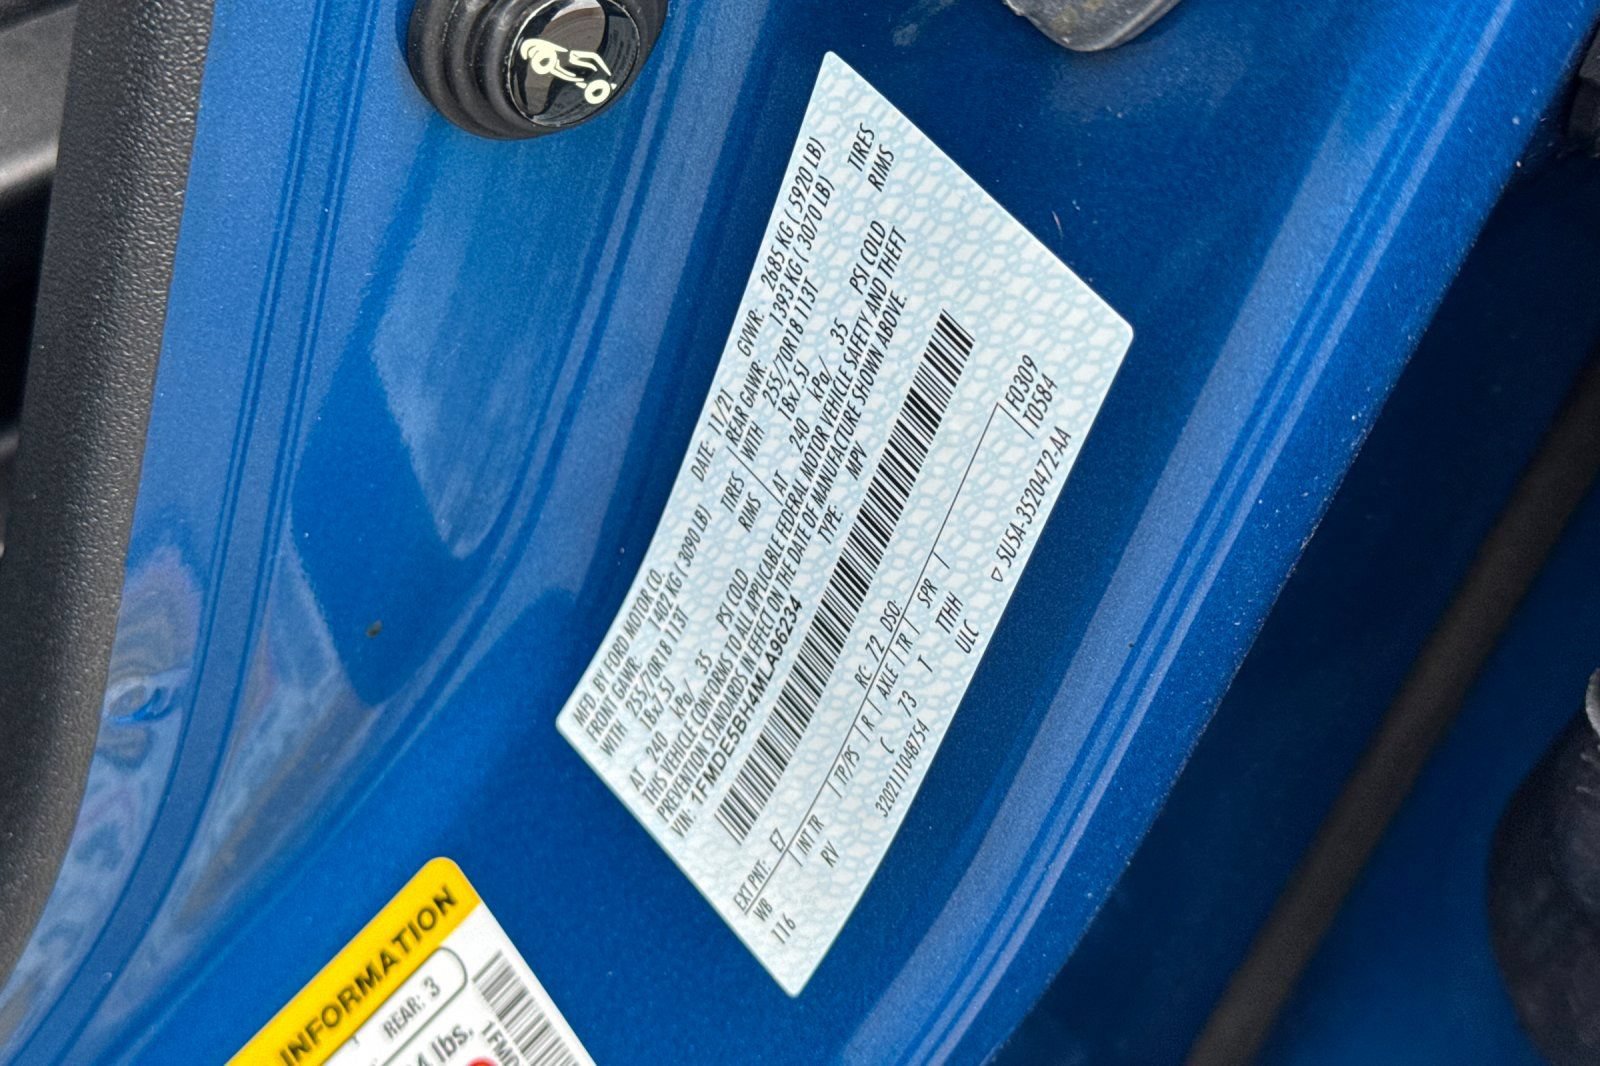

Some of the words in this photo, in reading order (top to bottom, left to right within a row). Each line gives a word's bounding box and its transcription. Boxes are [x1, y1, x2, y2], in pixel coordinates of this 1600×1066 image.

[737, 309, 764, 357] GVWR:
[761, 245, 785, 292] 2685
[775, 221, 794, 250] KG
[788, 166, 813, 213] 5920
[803, 137, 826, 169] LB)
[740, 421, 764, 461] WITH
[762, 318, 804, 407] 255/70R18
[794, 277, 818, 320] 113T
[847, 123, 875, 172] TIRES
[778, 359, 810, 421] 18x7.5J
[868, 144, 894, 192] RIMS
[725, 405, 749, 447] REAR
[740, 360, 767, 408] GAWR:
[769, 283, 794, 326] 1393
[784, 258, 803, 287] KG
[797, 204, 822, 251] 3070
[812, 175, 835, 207] LB)
[772, 470, 788, 497] AT
[789, 417, 810, 453] 240
[807, 356, 833, 403] kPa/
[830, 317, 848, 346] 35
[849, 263, 870, 295] PSI
[860, 220, 885, 266] COLD
[875, 291, 907, 349] ABOVE.
[852, 343, 884, 406] SHOWN
[1005, 355, 1038, 412] F0309
[1022, 373, 1057, 429] T0584
[691, 441, 715, 482] DATE:
[708, 388, 734, 436] 11/21
[810, 400, 862, 509] MANUFACTURE
[641, 771, 667, 805] THIS
[660, 720, 698, 776] VEHICLE
[691, 652, 733, 726] CONFORMS
[724, 634, 742, 658] TO
[734, 611, 754, 640] ALL
[745, 534, 785, 616] APPLICABLE
[775, 478, 809, 540] FEDERAL
[799, 425, 830, 482] MOTOR
[819, 365, 853, 428] VEHICLE
[843, 310, 873, 370] SAFETY
[865, 277, 887, 317] AND
[877, 226, 906, 279] THEFT
[802, 502, 818, 529] OF
[817, 505, 843, 544] TYPE:
[845, 441, 867, 481] MPV
[996, 426, 1071, 568] 5U5A-3520472-AA
[775, 558, 797, 591] THE
[787, 523, 811, 565] DATE
[573, 693, 596, 727] MFD.
[592, 669, 609, 693] BY
[603, 635, 629, 674] FORD
[623, 588, 654, 639] MOTOR
[646, 568, 665, 592] CO.
[586, 695, 617, 742] FRONT
[612, 657, 641, 700] GAWR:
[648, 592, 673, 631] 1402
[665, 572, 682, 597] KG
[678, 527, 701, 567] 3090
[692, 504, 712, 533] LB)
[600, 720, 627, 757] WITH
[625, 639, 672, 717] 255/70R18
[665, 605, 689, 643] 113T
[720, 471, 744, 513] TIRES
[639, 675, 675, 731] 18x7.5J
[738, 492, 761, 533] RIMS
[747, 607, 775, 658] EFFECT
[767, 586, 785, 613] ON
[854, 665, 872, 690] RC:
[865, 635, 885, 662] 72
[880, 600, 902, 633] DSO:
[955, 619, 979, 654] ULC
[629, 766, 646, 791] AT
[645, 731, 668, 764] 240
[669, 678, 695, 720] kPa/
[694, 649, 712, 675] 35
[715, 602, 735, 631] PSI
[726, 568, 749, 607] COLD
[702, 668, 748, 747] STANDARDS
[740, 652, 756, 674] IN
[671, 810, 696, 838] VIN:
[692, 594, 802, 804] 1FMDE5BH4MLA96234
[753, 898, 772, 922] WB
[796, 828, 815, 856] INT
[807, 814, 824, 834] TR
[834, 745, 860, 785] TP/PS
[861, 715, 875, 731] R
[876, 663, 898, 700] AXLE
[895, 632, 913, 654] TR
[917, 578, 938, 609] SPR
[657, 741, 710, 822] PREVENTION
[771, 913, 796, 944] 116
[820, 841, 839, 868] RV
[897, 690, 917, 717] 73
[917, 655, 933, 672] T
[935, 591, 963, 634] TTHH
[875, 718, 930, 818] 3202111048754
[733, 882, 753, 912] EXT
[747, 860, 771, 890] PNT:
[769, 828, 786, 853] E7
[279, 885, 458, 1066] INFORMATION
[383, 995, 426, 1039] REAR:
[423, 976, 441, 998] 3
[431, 1024, 475, 1063] lbs.
